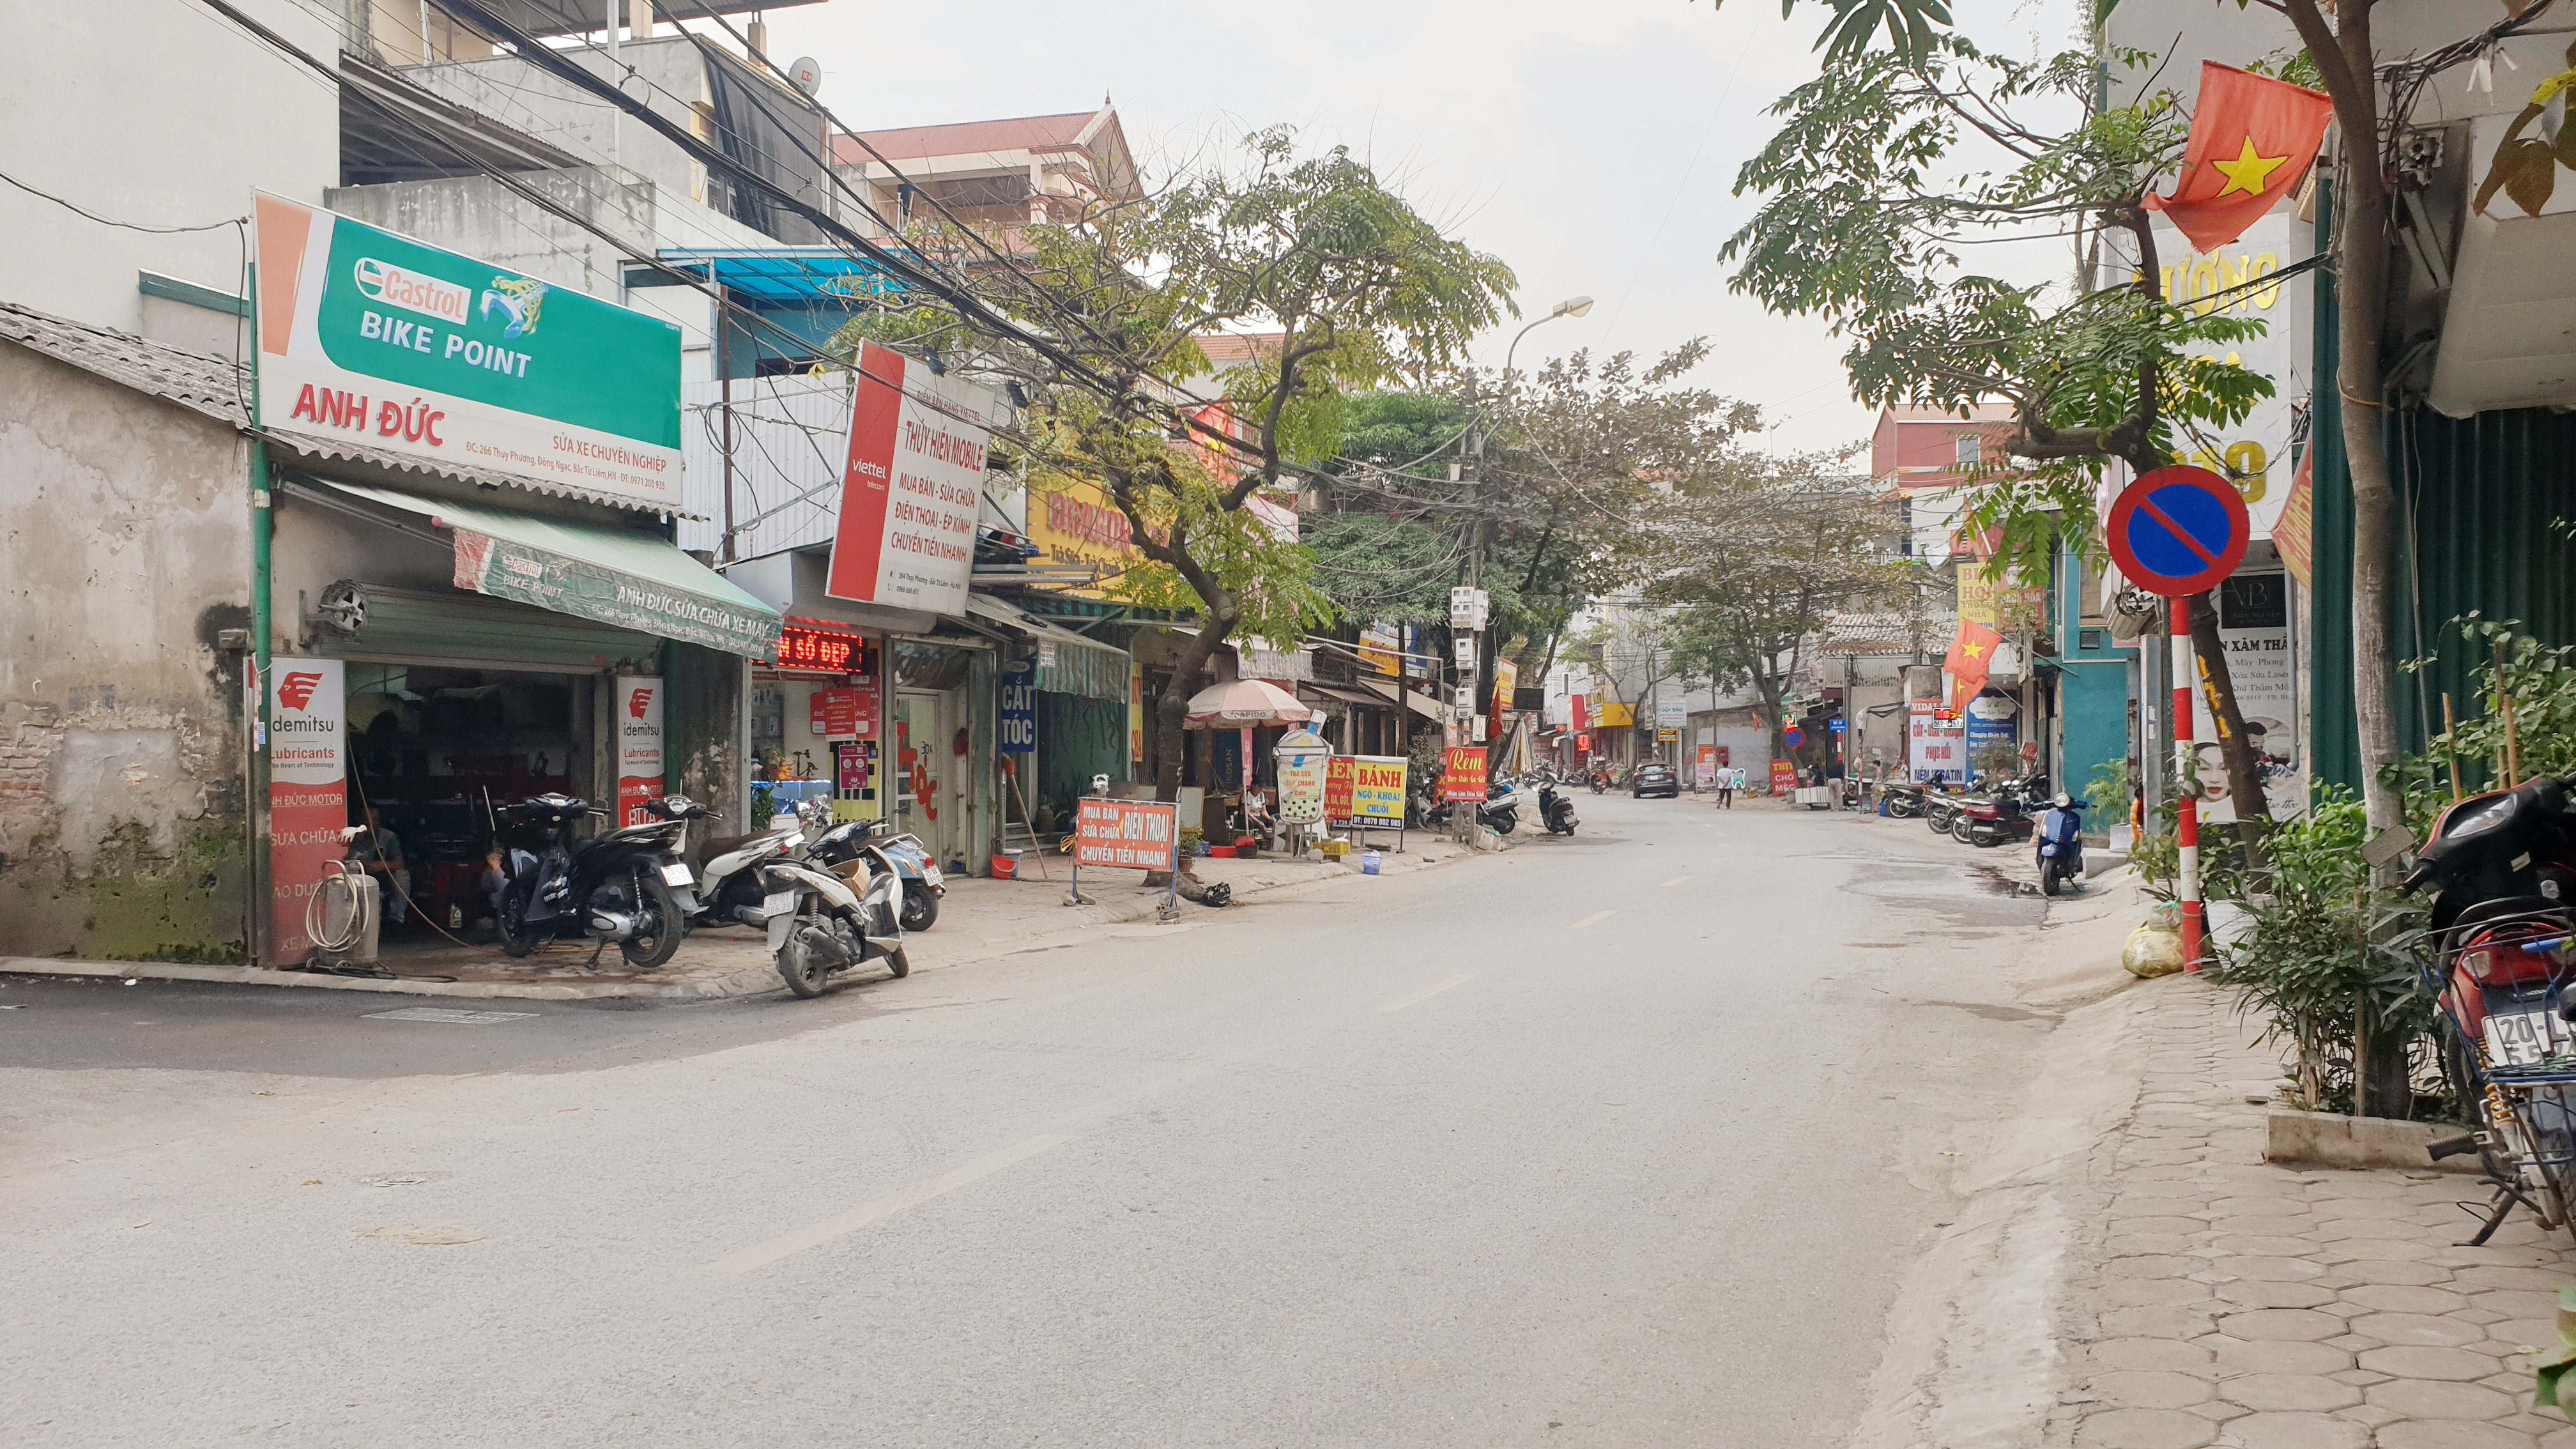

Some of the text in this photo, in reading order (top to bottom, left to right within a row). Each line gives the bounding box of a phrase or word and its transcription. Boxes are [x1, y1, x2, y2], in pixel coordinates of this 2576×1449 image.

[2135, 248, 2281, 316] ƯƠNG
[385, 270, 464, 319] Castrol
[360, 310, 532, 378] BIKE POINT
[291, 383, 445, 446] ANH ĐỨC
[553, 431, 666, 475] SỬA XE CHUYÊN NGHIỆP
[951, 436, 984, 472] MOBILE
[480, 445, 491, 456] 266
[631, 475, 643, 486] 0971
[645, 478, 655, 488] 200
[656, 480, 665, 491] 935
[852, 458, 886, 480] viettel
[898, 472, 917, 493] MUA
[918, 475, 935, 498] BÁN
[939, 480, 954, 503] SỬA
[895, 500, 971, 535] ĐIỆN THOẠI ÉP KÍNH
[940, 542, 967, 563] NHANH
[503, 574, 564, 599] BIKE POINT
[617, 585, 646, 607] ANH
[732, 615, 745, 633] XE
[2232, 637, 2260, 652] XĂM
[2258, 658, 2284, 668] Phong
[1002, 675, 1033, 710] CẮT
[272, 715, 334, 732] demitsu
[624, 723, 659, 736] idemitsu
[1002, 714, 1033, 745] TÓC
[624, 748, 660, 758] Lubricants
[1450, 749, 1483, 770] Rèm
[1358, 765, 1402, 788] BÁNH
[1775, 772, 1794, 782] CHÓ
[272, 792, 343, 806] NH ĐỨC MOTOR
[1377, 792, 1400, 801] KHOAI
[1083, 806, 1119, 820] MUA BÁN
[1082, 820, 1120, 839] SỬA CHỮA
[1124, 806, 1169, 848] ĐIỆN THOẠI
[1080, 841, 1167, 866] CHUYỂN TIỀN NHANH
[281, 937, 299, 951] XE
